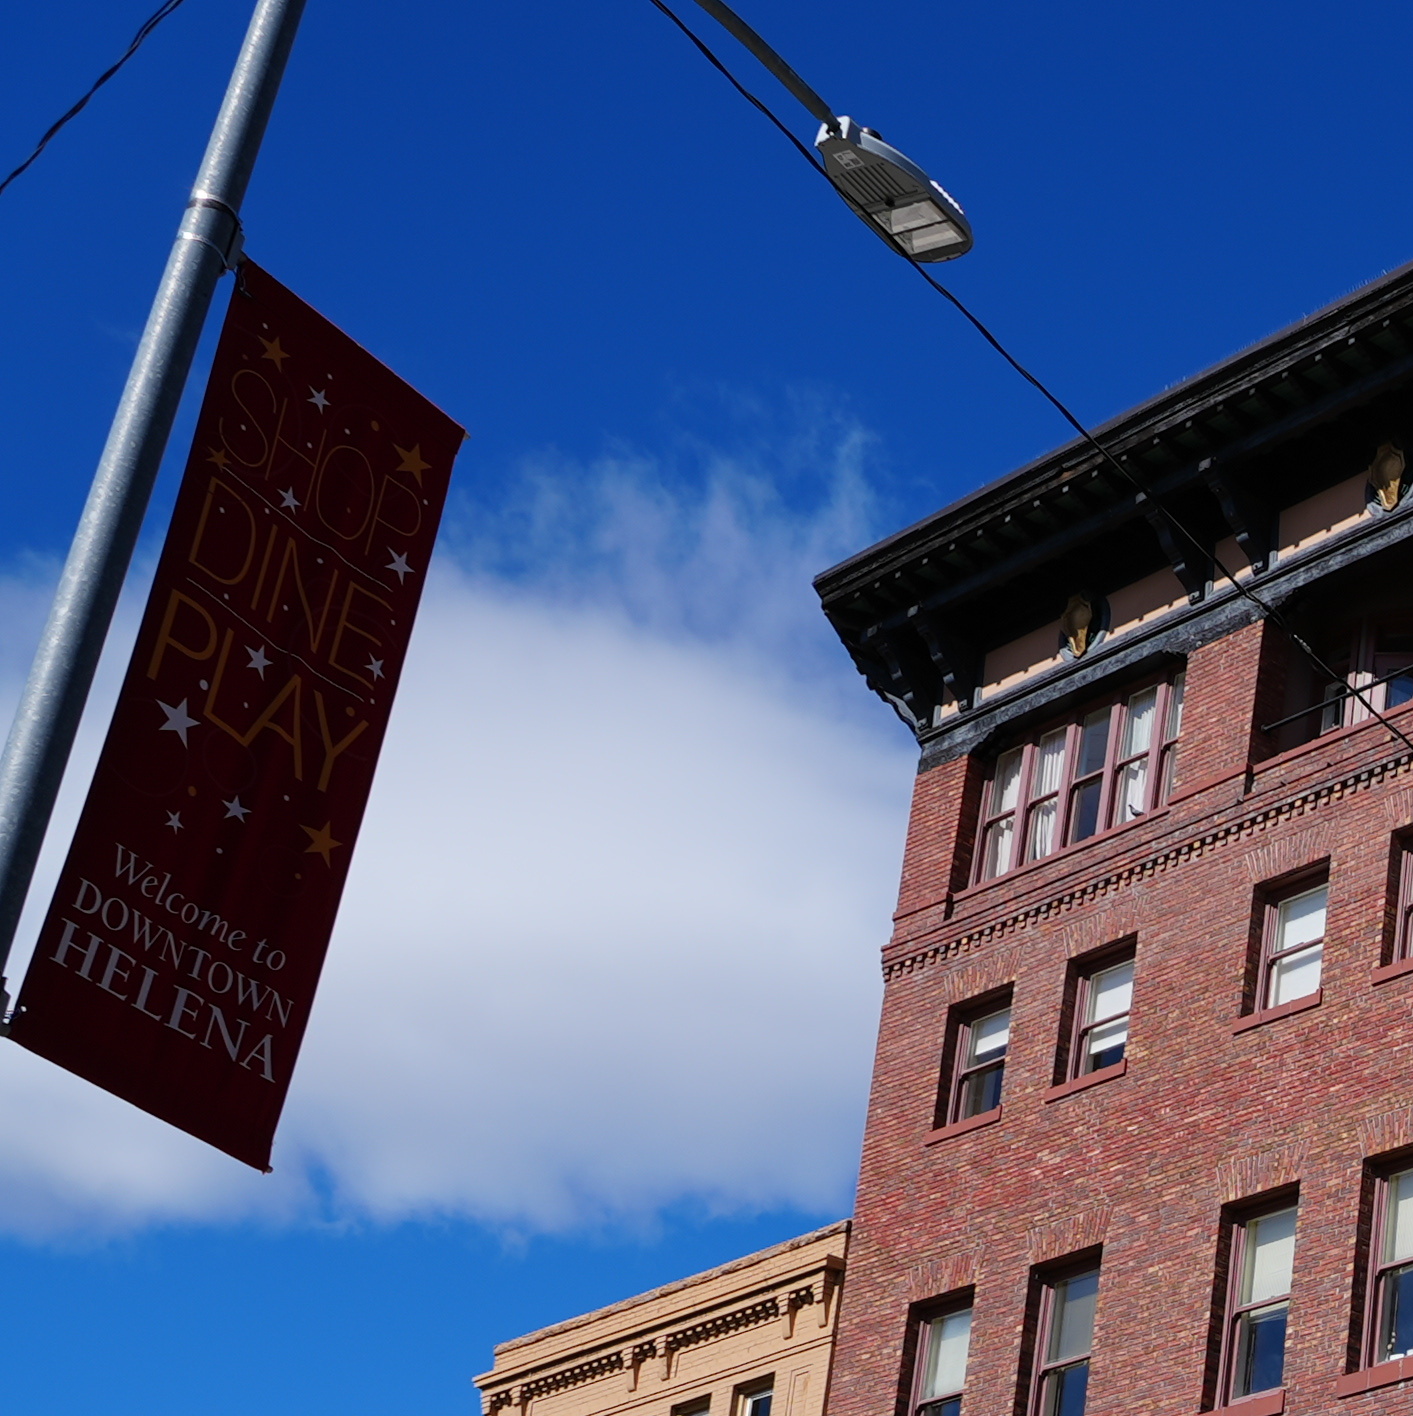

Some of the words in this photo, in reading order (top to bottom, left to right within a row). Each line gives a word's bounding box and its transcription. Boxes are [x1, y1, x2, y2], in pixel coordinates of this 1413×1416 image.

[219, 369, 422, 555] SHOP
[188, 476, 394, 690] DINE
[146, 588, 369, 793] PLAY
[71, 877, 295, 1028] DOWNTOWN
[115, 842, 248, 951] Welcome
[252, 938, 286, 971] to
[49, 917, 276, 1084] HELENA
